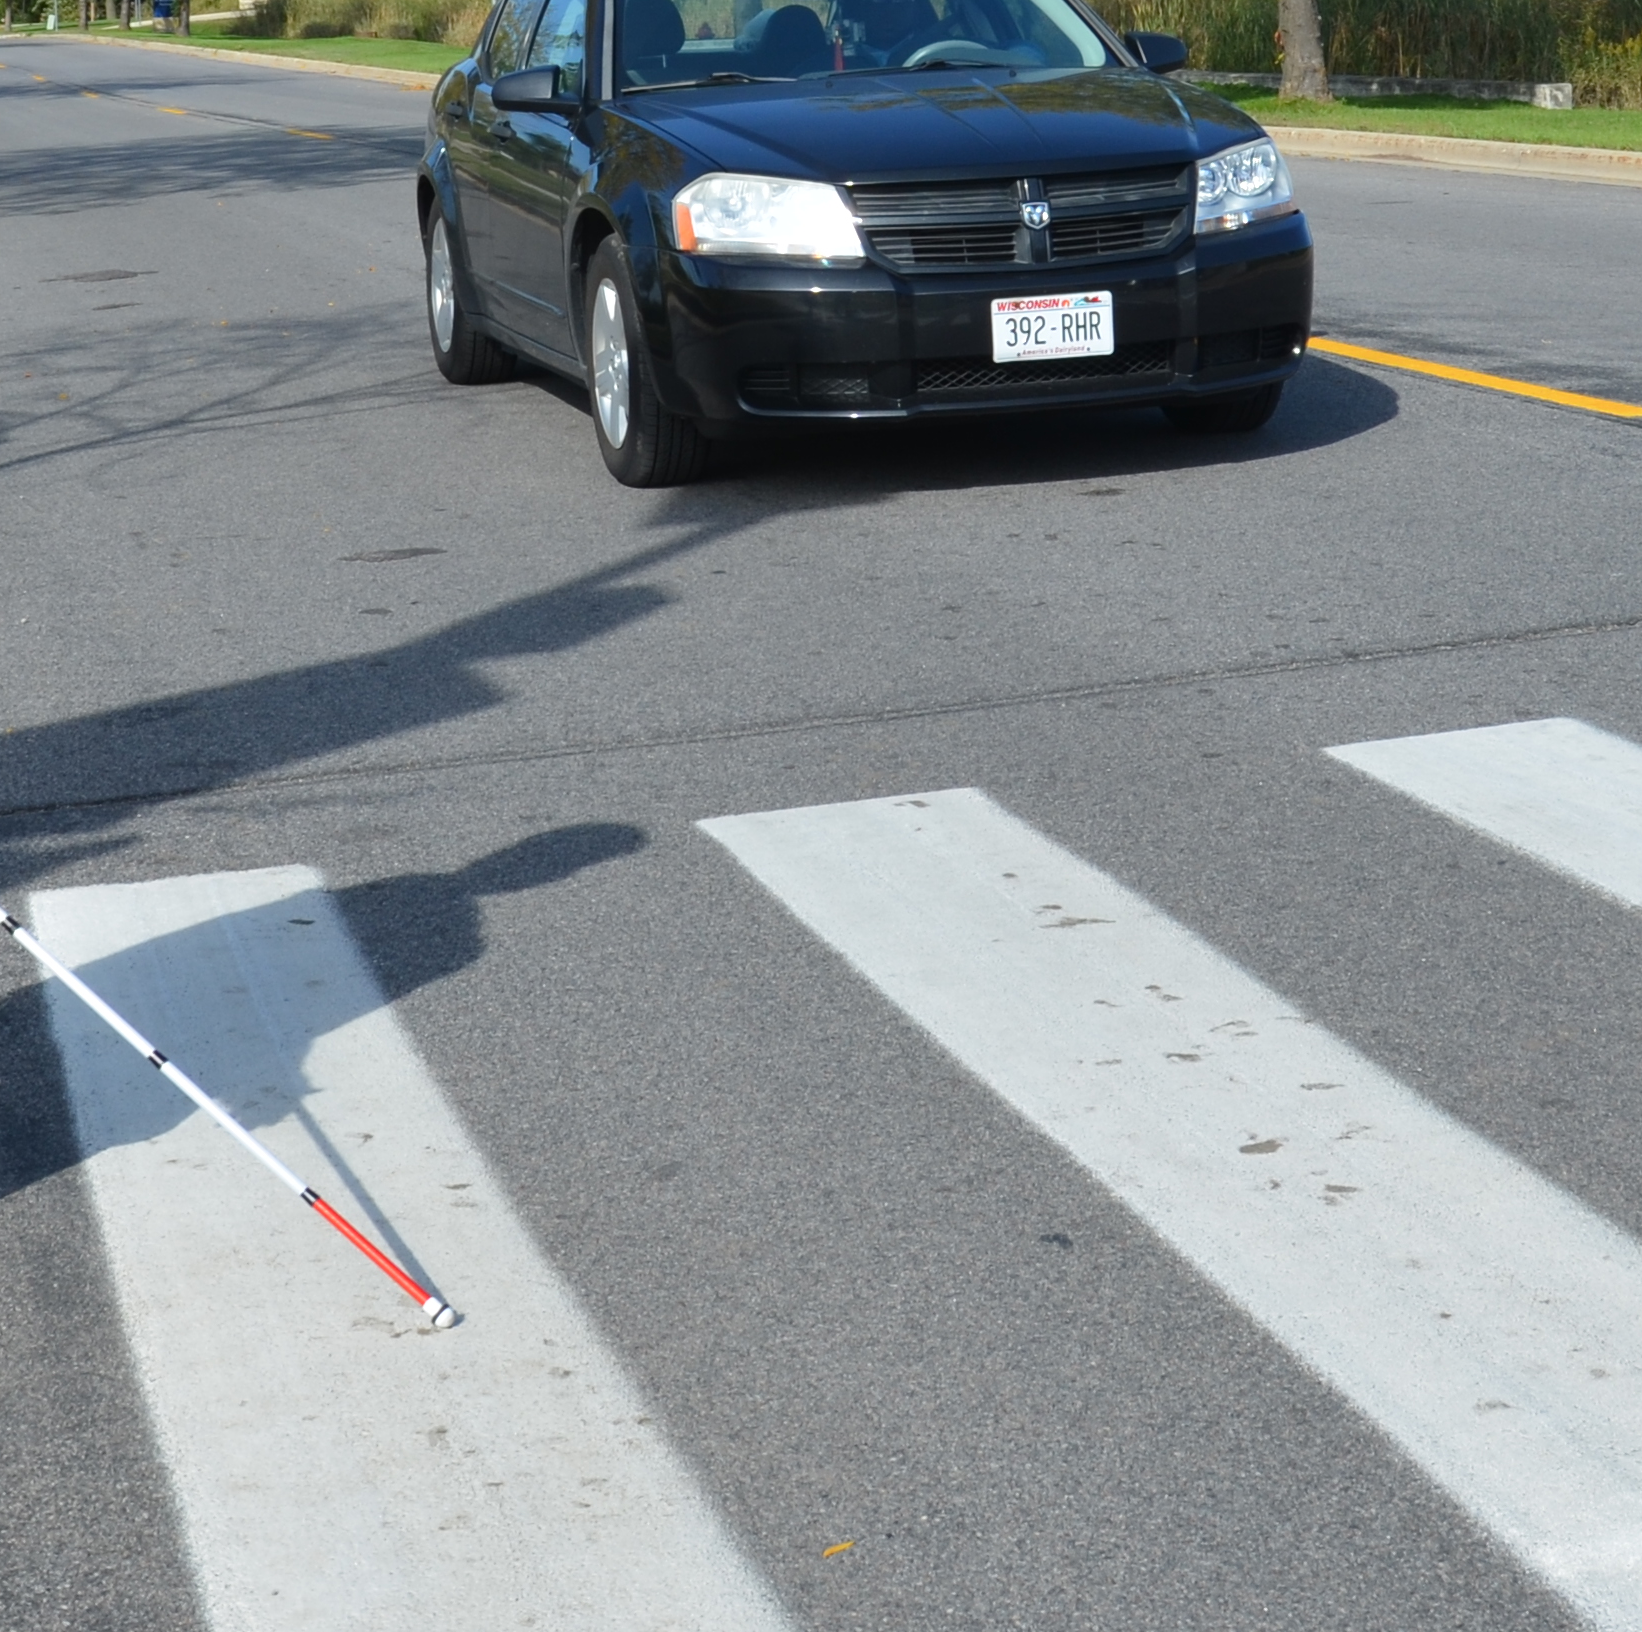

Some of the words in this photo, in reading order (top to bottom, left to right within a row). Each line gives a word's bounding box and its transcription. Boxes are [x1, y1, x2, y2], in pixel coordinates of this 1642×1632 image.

[997, 298, 1060, 312] WISCONSIN
[1005, 311, 1101, 347] 392-RHR
[1021, 347, 1054, 356] America's
[1055, 345, 1085, 354] Dairyland
